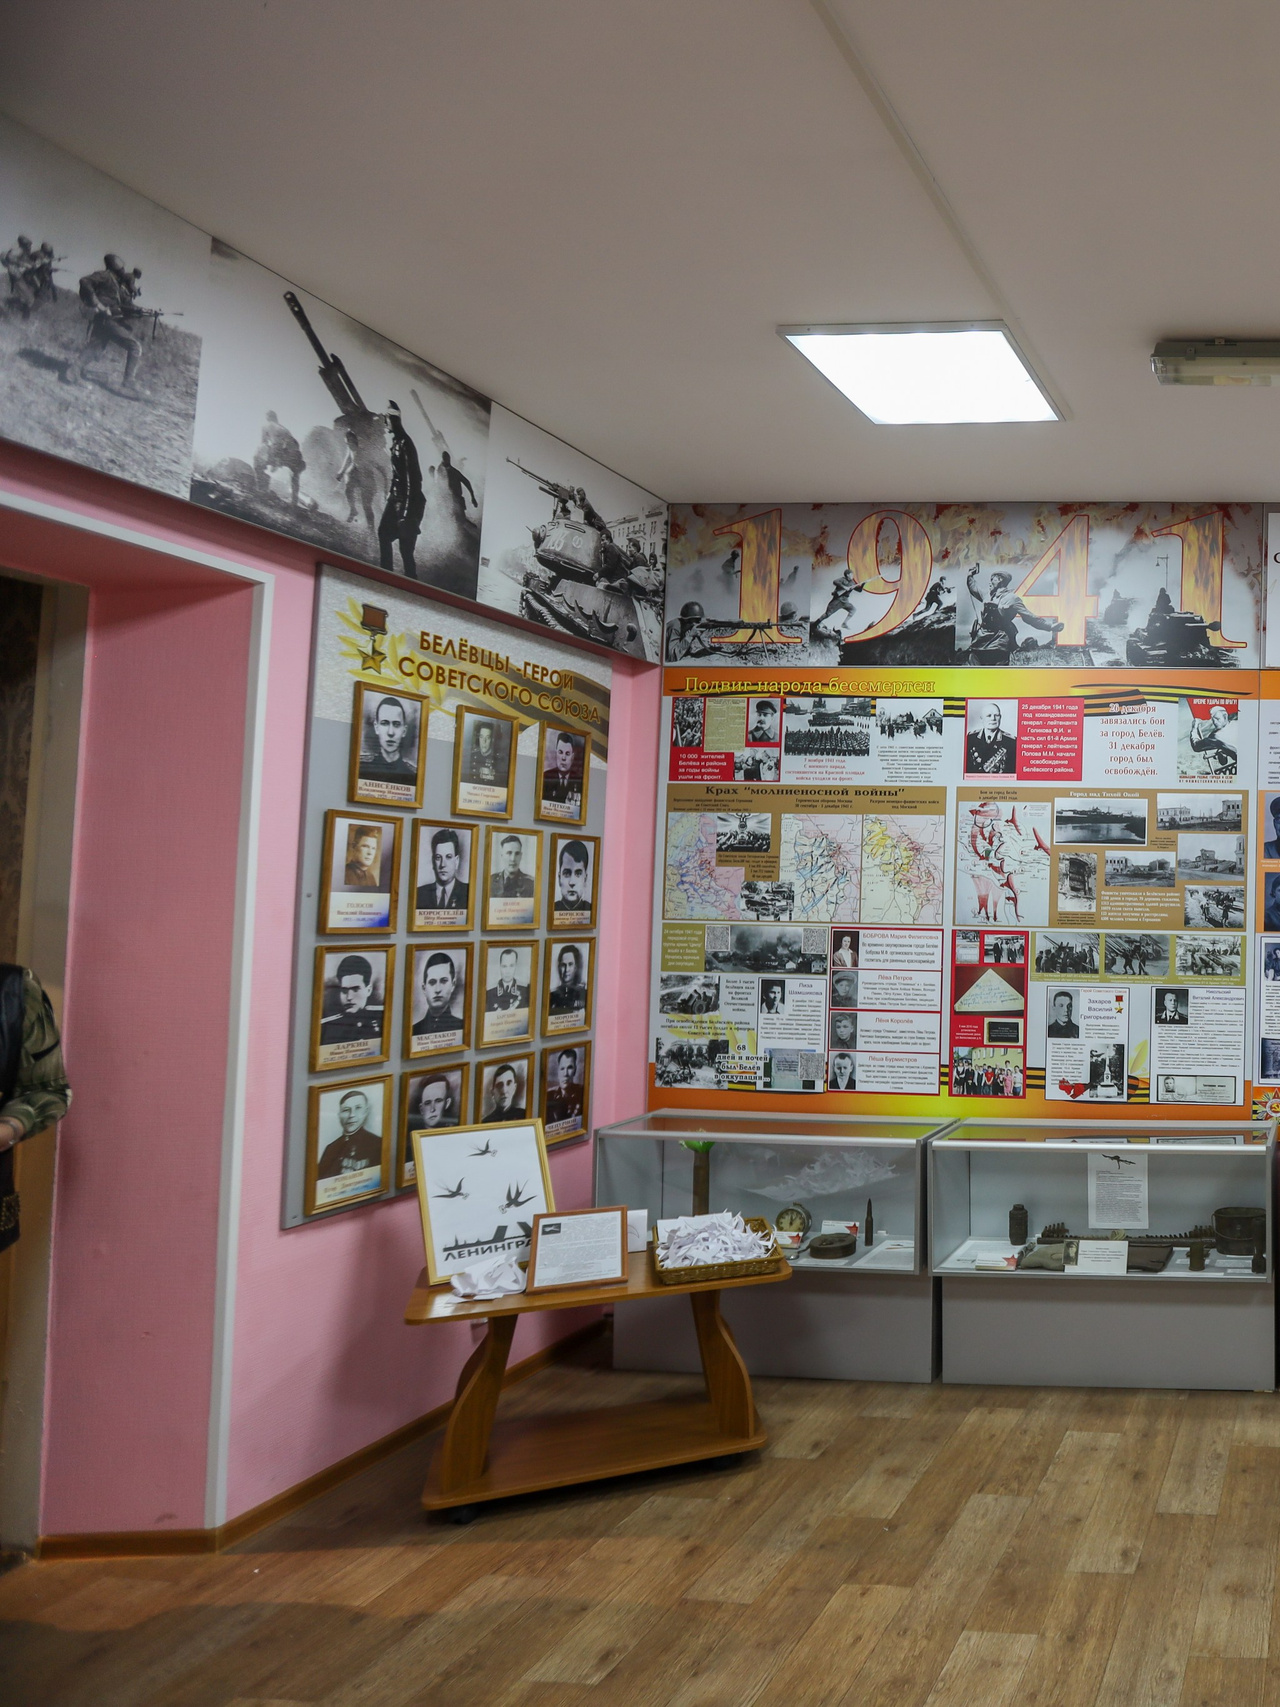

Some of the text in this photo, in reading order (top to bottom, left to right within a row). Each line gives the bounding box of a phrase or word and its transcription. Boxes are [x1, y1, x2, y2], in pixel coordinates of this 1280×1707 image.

[420, 631, 509, 672] БЕЛЁВЦЫ
[399, 657, 600, 723] СОВЕТСКОГО СОЮЗА
[685, 677, 935, 696] Подвиг народа бессмертен
[1109, 703, 1156, 714] 26 декабря
[1150, 717, 1165, 725] бои
[1139, 729, 1165, 738] Белёв.
[1121, 742, 1155, 751] декабря
[1105, 768, 1158, 776] освобождён.
[706, 786, 739, 797] Крах
[444, 1239, 532, 1261] ЛЕНИНГРА
